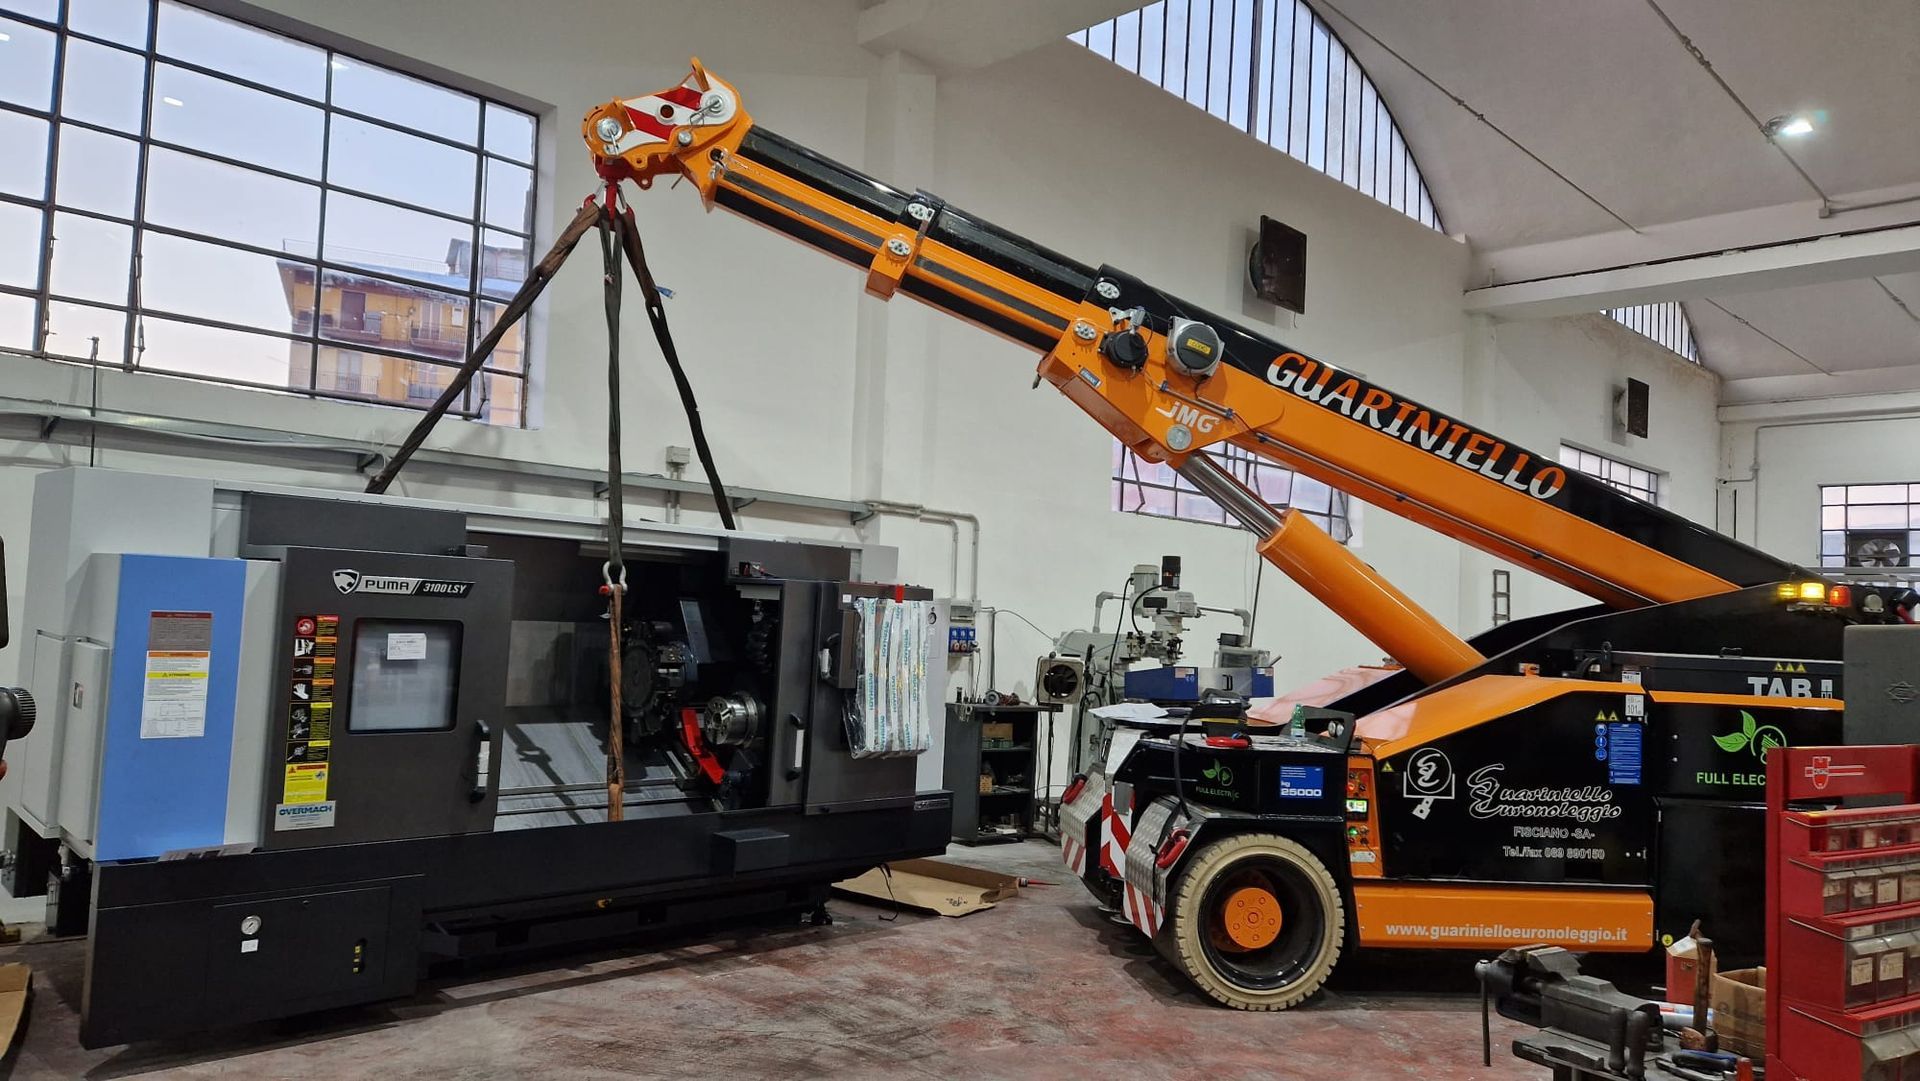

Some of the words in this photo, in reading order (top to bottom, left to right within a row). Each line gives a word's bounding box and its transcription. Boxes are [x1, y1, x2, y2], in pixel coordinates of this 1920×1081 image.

[1266, 352, 1567, 499] GUARINIELLO
[365, 580, 410, 591] PUMA
[1280, 780, 1291, 788] kg
[1467, 763, 1613, 802] Guariniello
[1697, 772, 1729, 785] FULL
[1733, 773, 1766, 786] ELEC
[1195, 786, 1210, 795] FULL
[1280, 788, 1322, 797] 25000
[279, 805, 333, 816] OVERMACH
[1469, 799, 1622, 822] Euronoleggio
[1513, 826, 1569, 839] FISCIANO
[1386, 924, 1628, 943] www.guarinielloeuronoleggio.it
